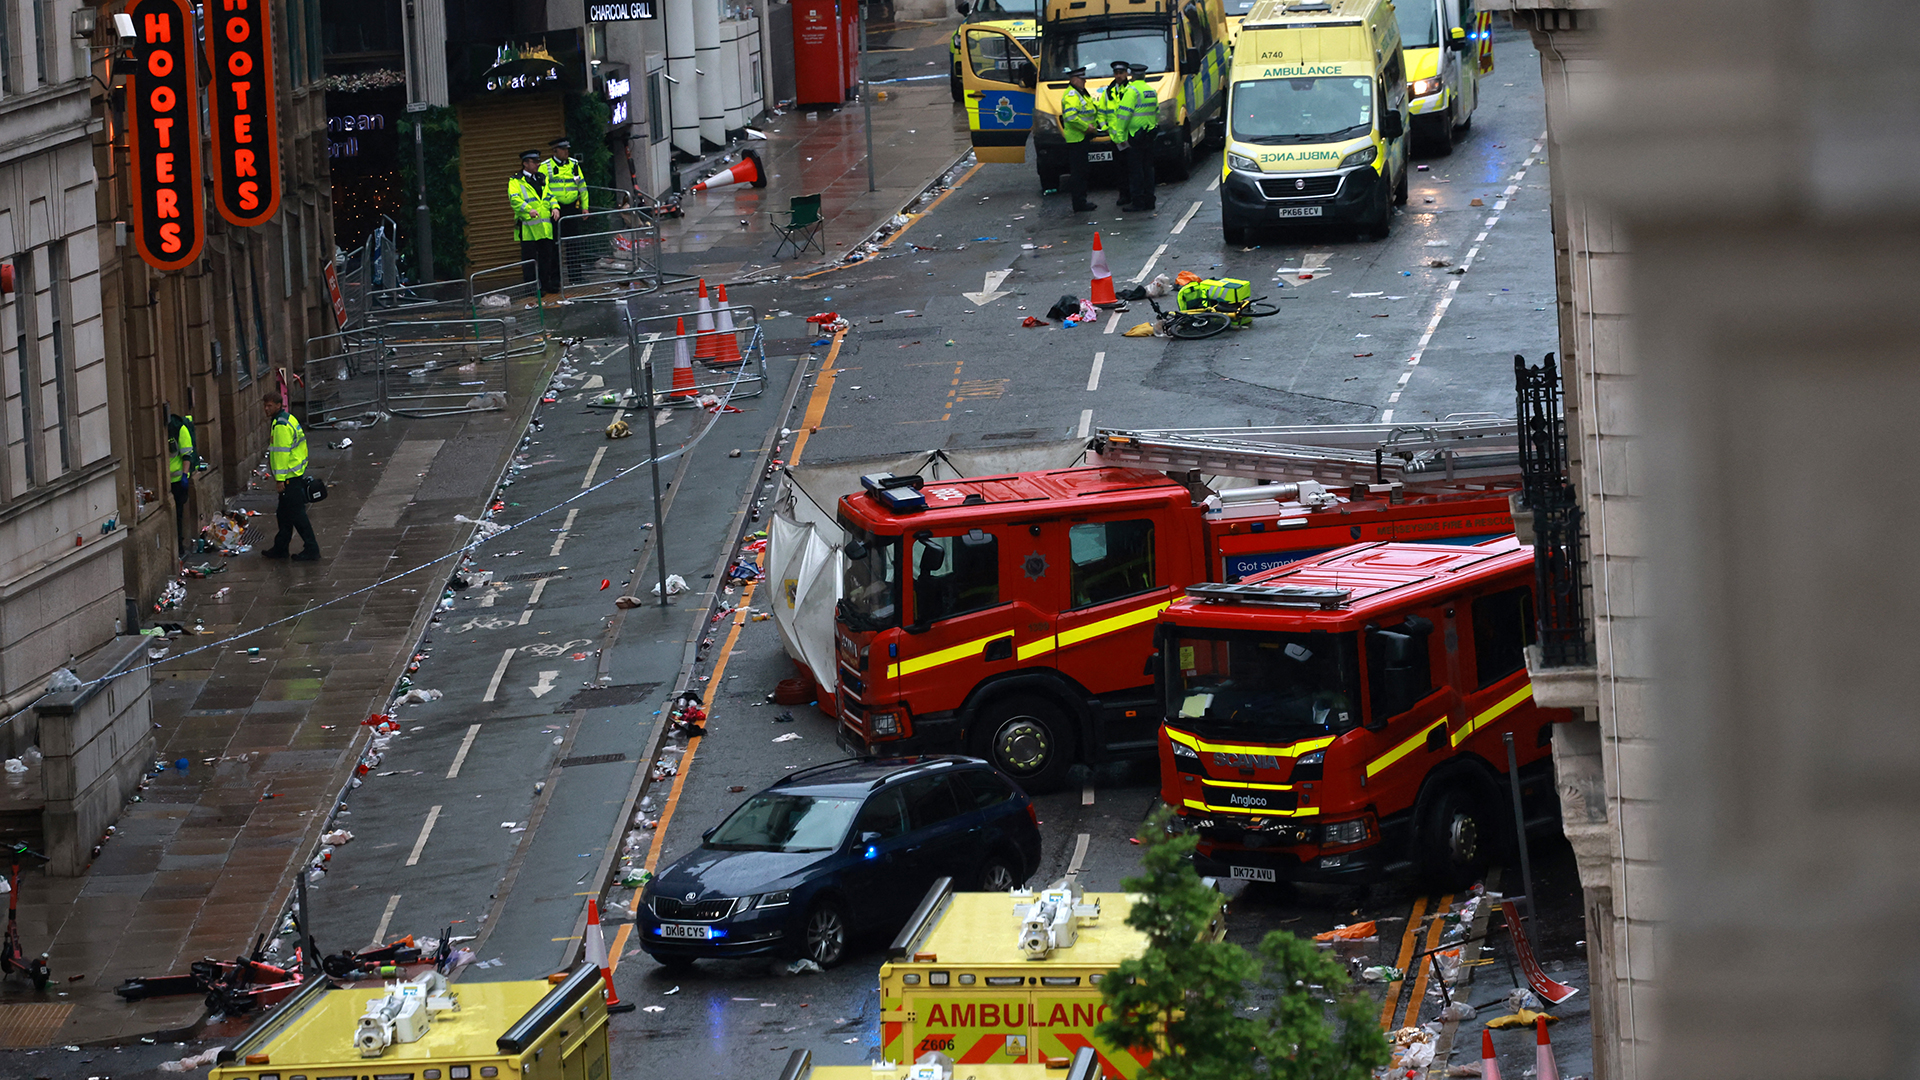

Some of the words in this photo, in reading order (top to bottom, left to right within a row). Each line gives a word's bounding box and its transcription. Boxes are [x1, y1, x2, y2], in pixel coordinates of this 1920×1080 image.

[590, 4, 630, 21] CHARCOAL
[631, 2, 652, 19] GRILL
[1261, 51, 1283, 59] A740
[1263, 66, 1342, 77] AMBULANCE
[144, 13, 182, 254] HOOTERS
[1282, 208, 1302, 217] PK66
[1304, 207, 1319, 216] ECV
[1377, 522, 1440, 535] MERSEYSIDE
[1442, 520, 1463, 530] FIRE
[1465, 519, 1472, 527] &
[1474, 516, 1514, 527] RESCUE
[1237, 562, 1257, 572] Got
[1213, 752, 1280, 770] SCANIA
[1230, 794, 1267, 807] Angloco
[1233, 867, 1255, 878] DK72
[1257, 869, 1272, 880] AVU
[666, 926, 685, 937] DK18
[687, 927, 705, 937] CYS
[921, 1039, 955, 1051] Z606
